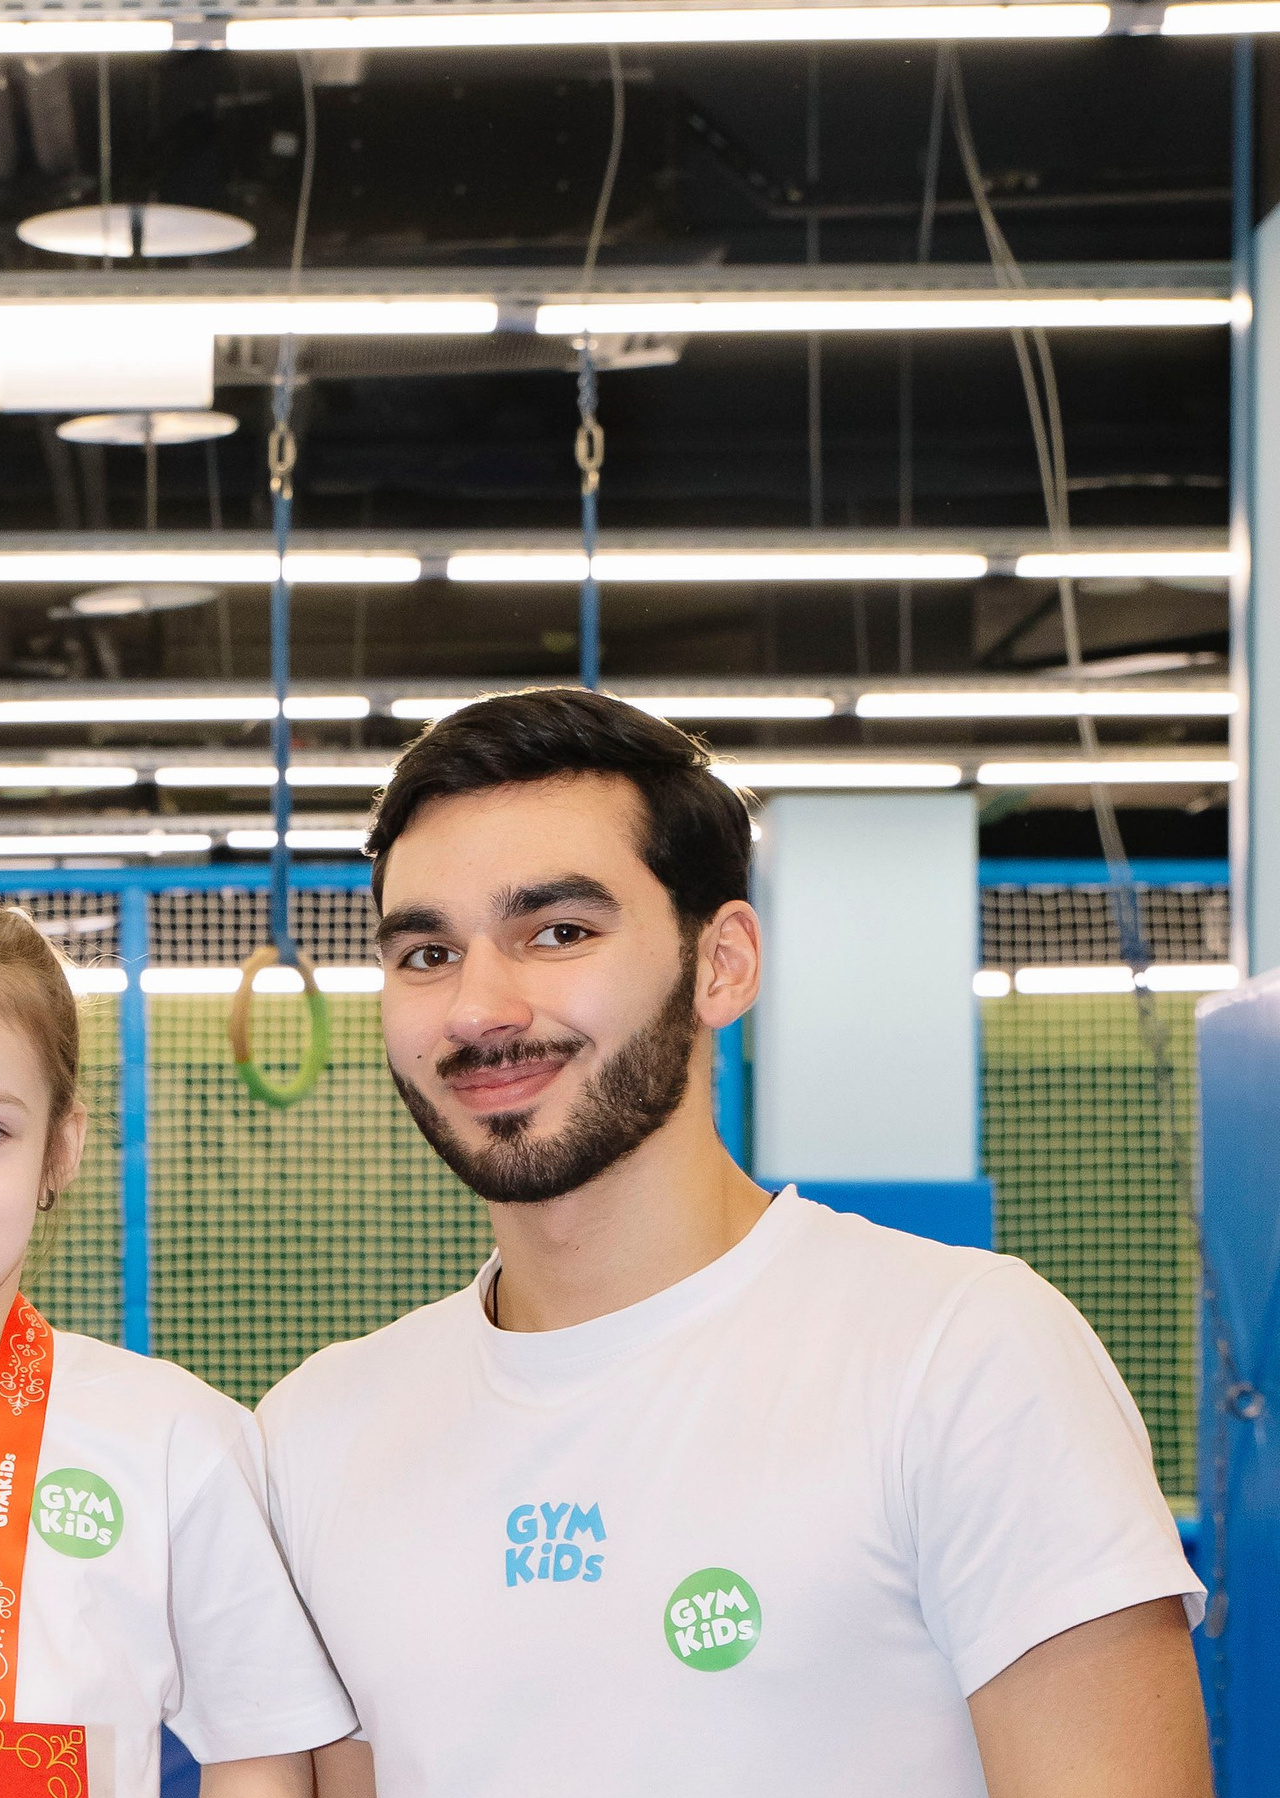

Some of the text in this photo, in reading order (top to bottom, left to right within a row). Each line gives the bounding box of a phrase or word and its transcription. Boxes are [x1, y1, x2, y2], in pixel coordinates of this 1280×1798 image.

[39, 1484, 115, 1522] GYM
[506, 1501, 607, 1545] GYM
[669, 1585, 750, 1628] GYM
